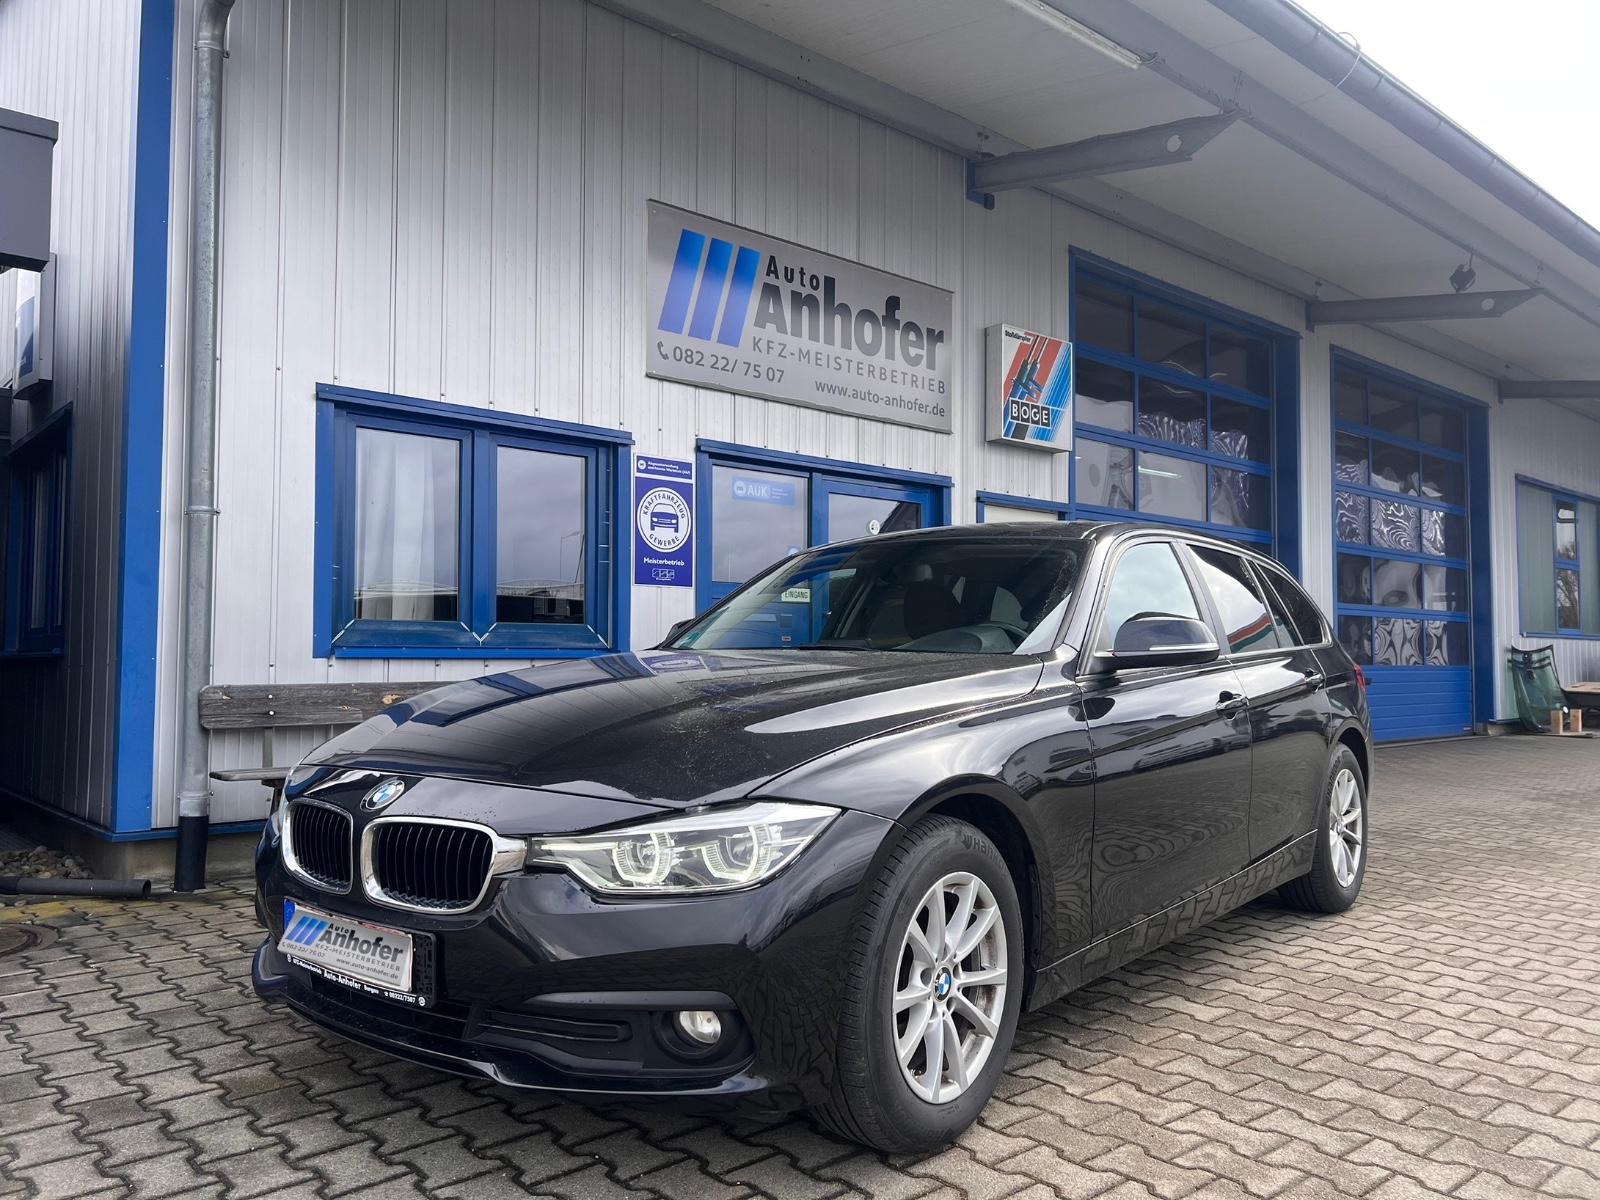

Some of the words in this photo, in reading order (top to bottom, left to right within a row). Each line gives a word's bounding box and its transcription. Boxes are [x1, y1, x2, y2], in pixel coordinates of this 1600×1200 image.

[765, 255, 820, 291] Auto
[753, 275, 945, 371] Anhofer
[673, 346, 705, 367] 082
[710, 354, 738, 374] 22/
[743, 361, 762, 379] 75
[766, 367, 785, 383] 07
[752, 336, 945, 394] KFZ-MEISTERBETRIEB
[815, 380, 945, 417] www.auto-anhofer.de
[1012, 403, 1049, 423] BOGE
[643, 493, 686, 519] KRAFTFAHRZEUG
[649, 533, 680, 547] GEWERBE
[643, 557, 685, 566] Meisterbetrieb
[784, 590, 809, 599] EINGANG
[328, 923, 350, 934] Auto
[315, 943, 401, 972] KFZ-MEISTERBETRIEB
[318, 930, 404, 962] Anhofer
[323, 968, 362, 990] Auto-Anhofer
[336, 958, 399, 980] www.auto-anhofer.de
